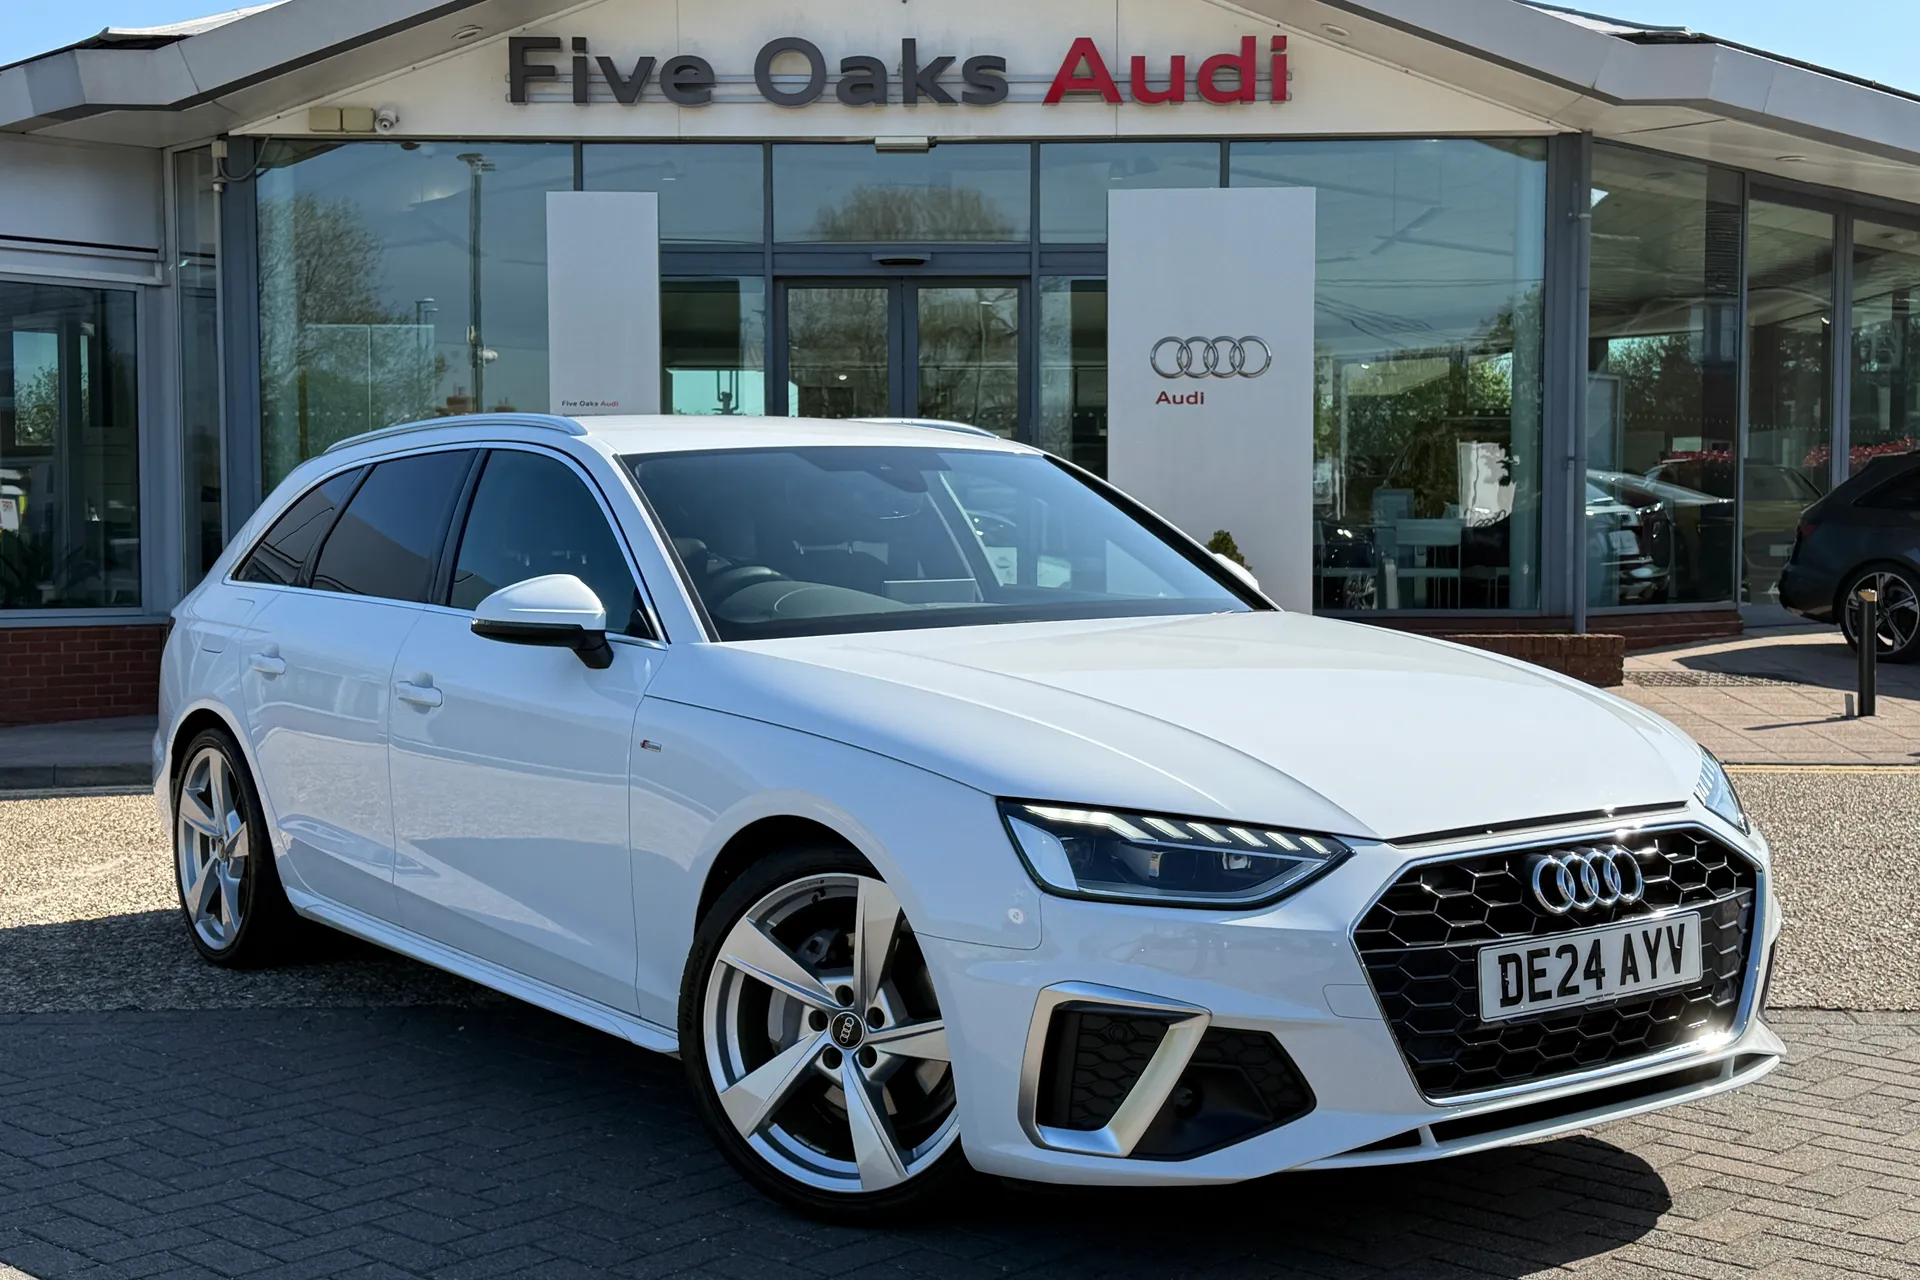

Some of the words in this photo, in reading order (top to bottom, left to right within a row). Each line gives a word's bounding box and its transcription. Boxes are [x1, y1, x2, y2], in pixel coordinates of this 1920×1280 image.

[509, 37, 716, 107] Five
[754, 37, 1009, 107] Oaks
[1043, 35, 1288, 105] Audi
[1155, 391, 1205, 405] Audi
[1498, 939, 1606, 1008] DE24
[1619, 922, 1686, 987] AYV
